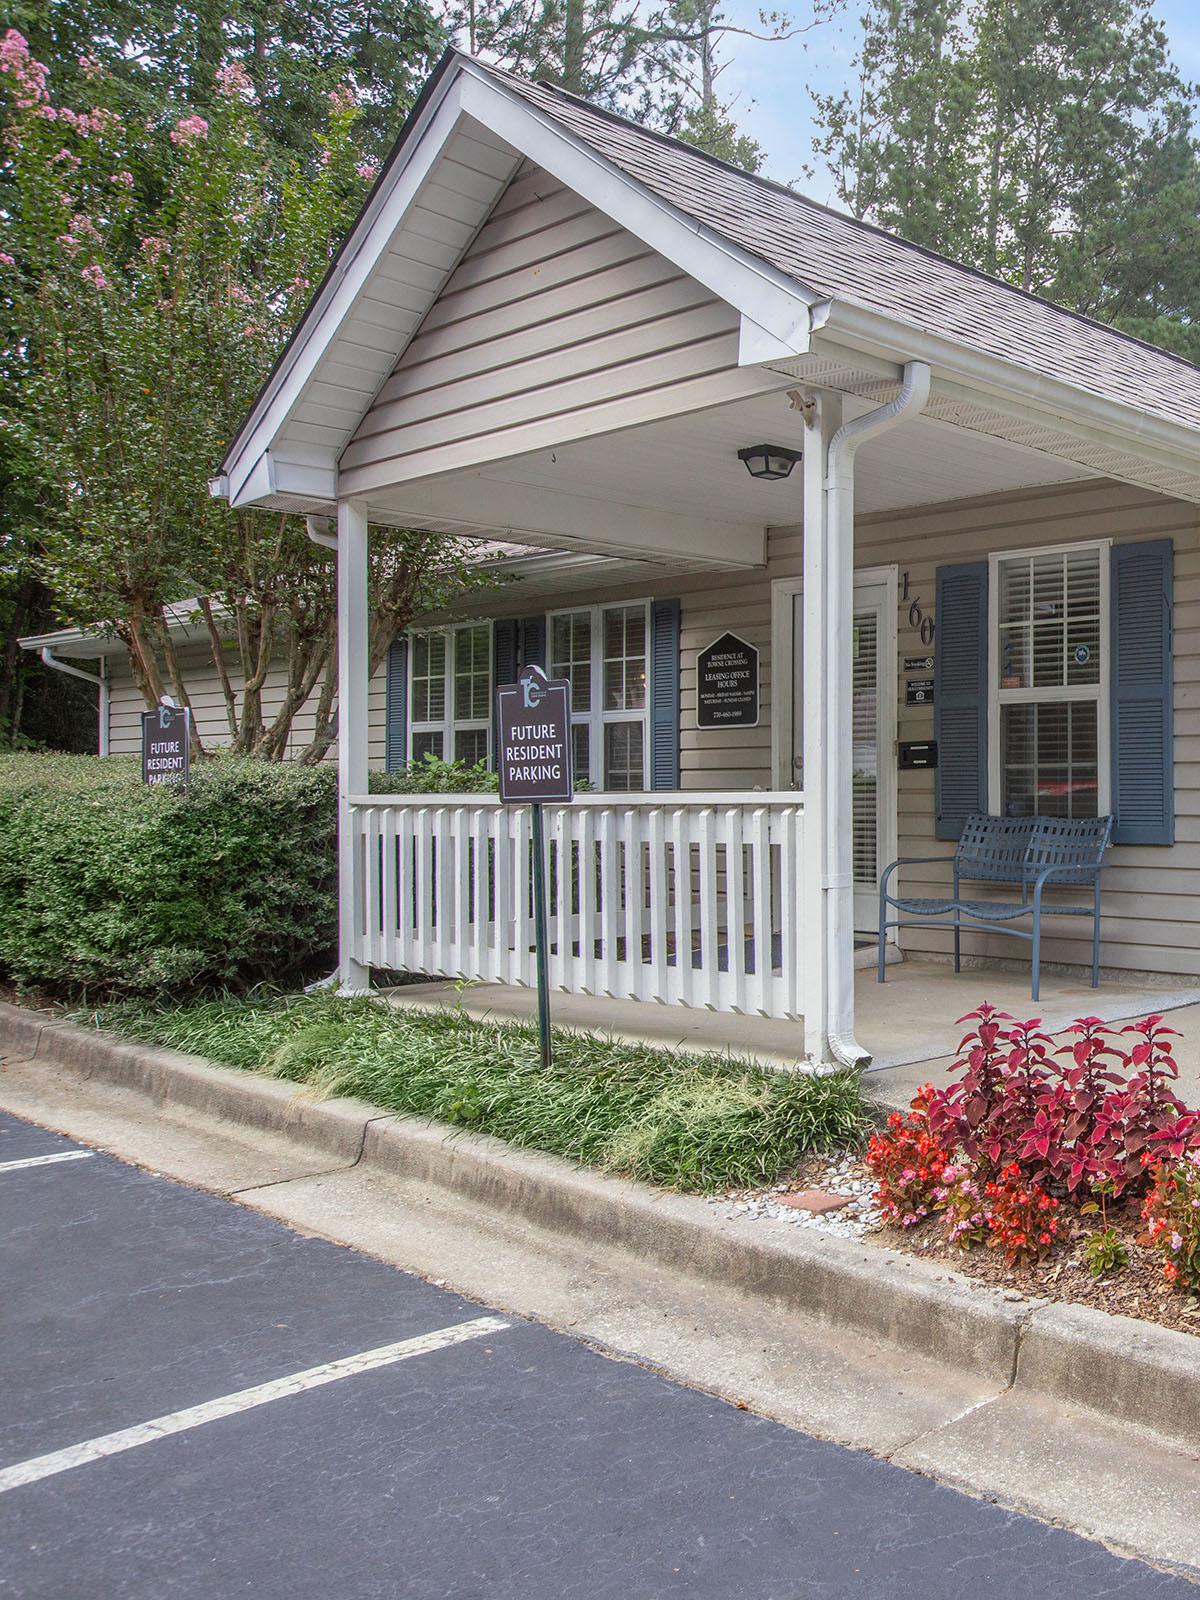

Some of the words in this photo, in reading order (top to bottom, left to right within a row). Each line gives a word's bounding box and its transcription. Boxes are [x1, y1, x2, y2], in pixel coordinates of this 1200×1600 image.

[705, 672, 729, 681] LEASING
[730, 670, 750, 679] OFFICE
[717, 680, 738, 688] HOURS
[511, 723, 556, 741] FUTURE
[151, 742, 179, 754] FUTURE
[506, 744, 563, 761] RESIDENT
[147, 757, 183, 770] RESIDENT
[509, 765, 560, 781] PARKING
